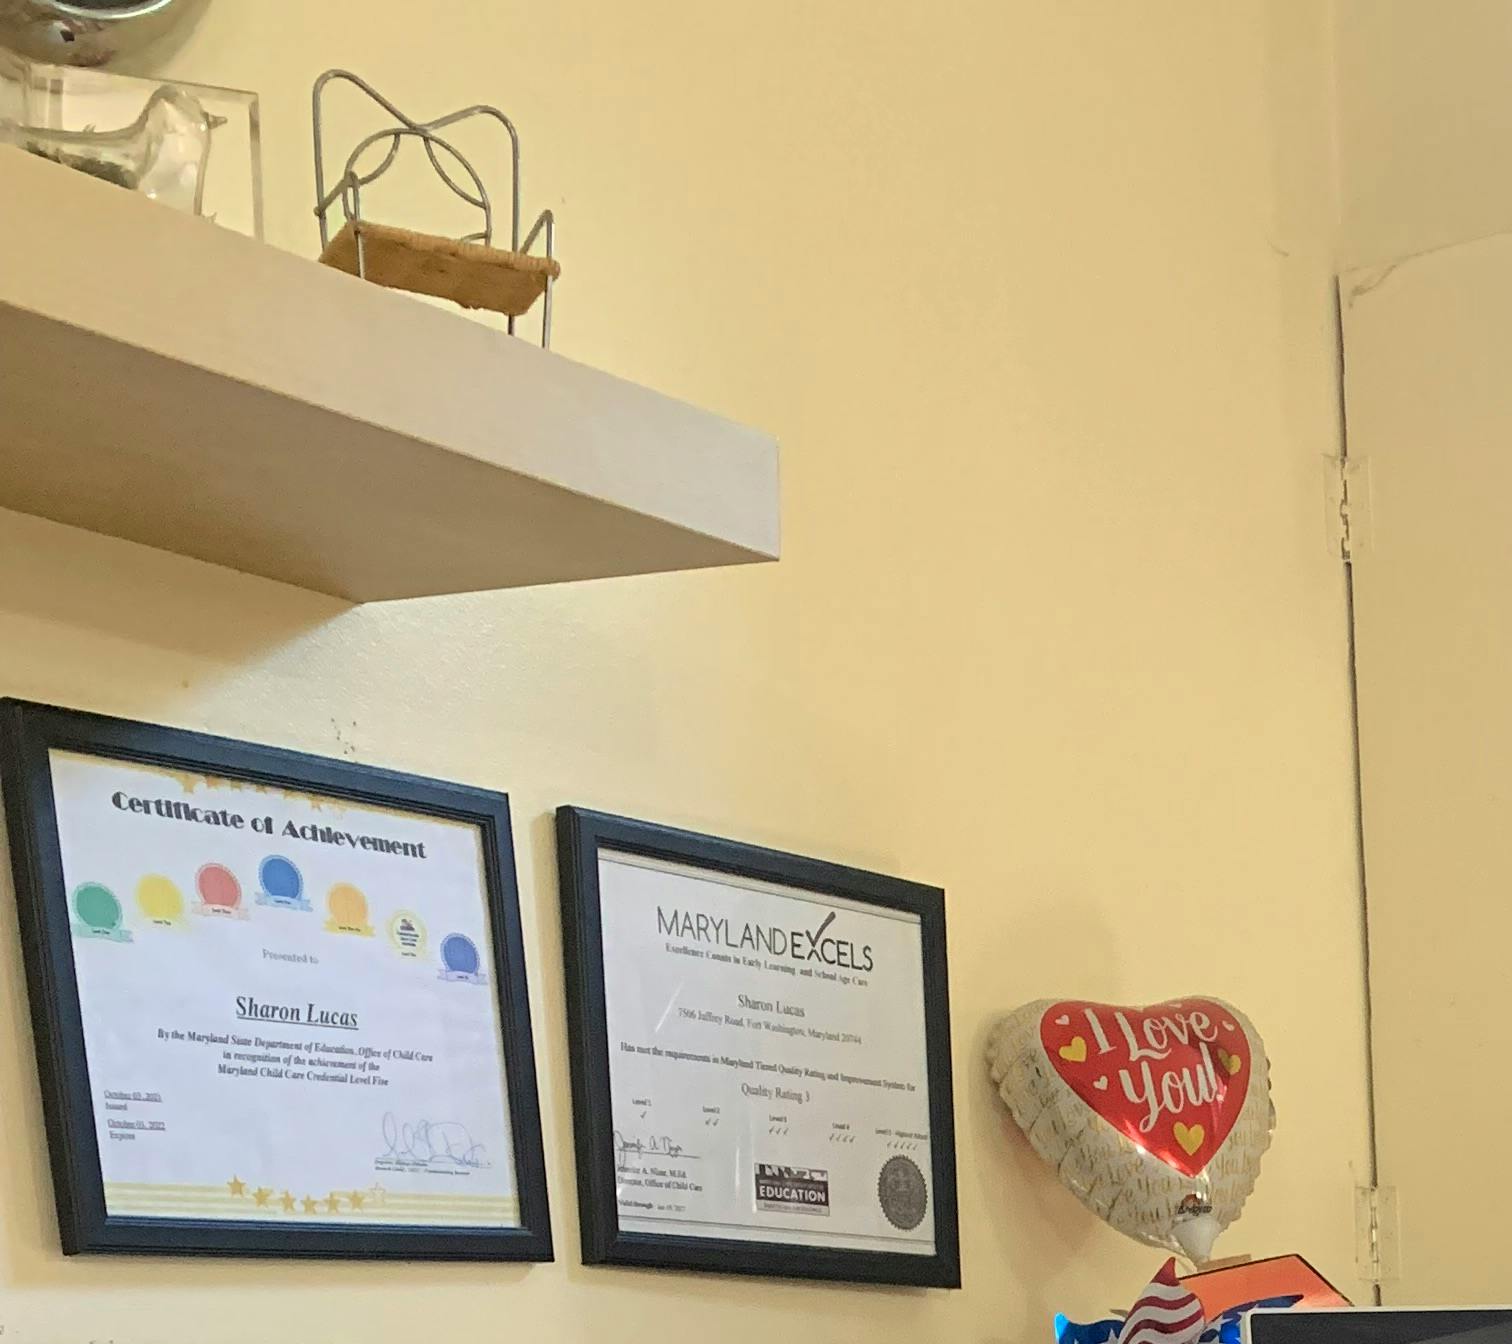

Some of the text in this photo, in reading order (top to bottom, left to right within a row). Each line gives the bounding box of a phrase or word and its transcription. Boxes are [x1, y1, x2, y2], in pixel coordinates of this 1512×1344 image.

[112, 791, 428, 859] Certificate of Achievement
[262, 949, 308, 964] Presented
[236, 996, 359, 1027] Sharon Lucas
[737, 994, 806, 1018] Sharon Lucas
[1084, 1008, 1218, 1061] I Love
[171, 1030, 186, 1041] the
[187, 1031, 229, 1046] Maryland
[254, 1037, 303, 1052] Department
[392, 1049, 414, 1062] Child
[414, 1052, 434, 1063] Care
[234, 1051, 281, 1066] recognition
[283, 1054, 292, 1067] of
[293, 1056, 306, 1066] the
[308, 1058, 357, 1070] achievement
[217, 1064, 258, 1079] Maryland
[260, 1066, 283, 1079] Child
[285, 1069, 305, 1081] Care
[741, 1082, 773, 1101] Quality
[775, 1087, 803, 1104] Rating
[759, 1185, 826, 1202] EDUCATION
